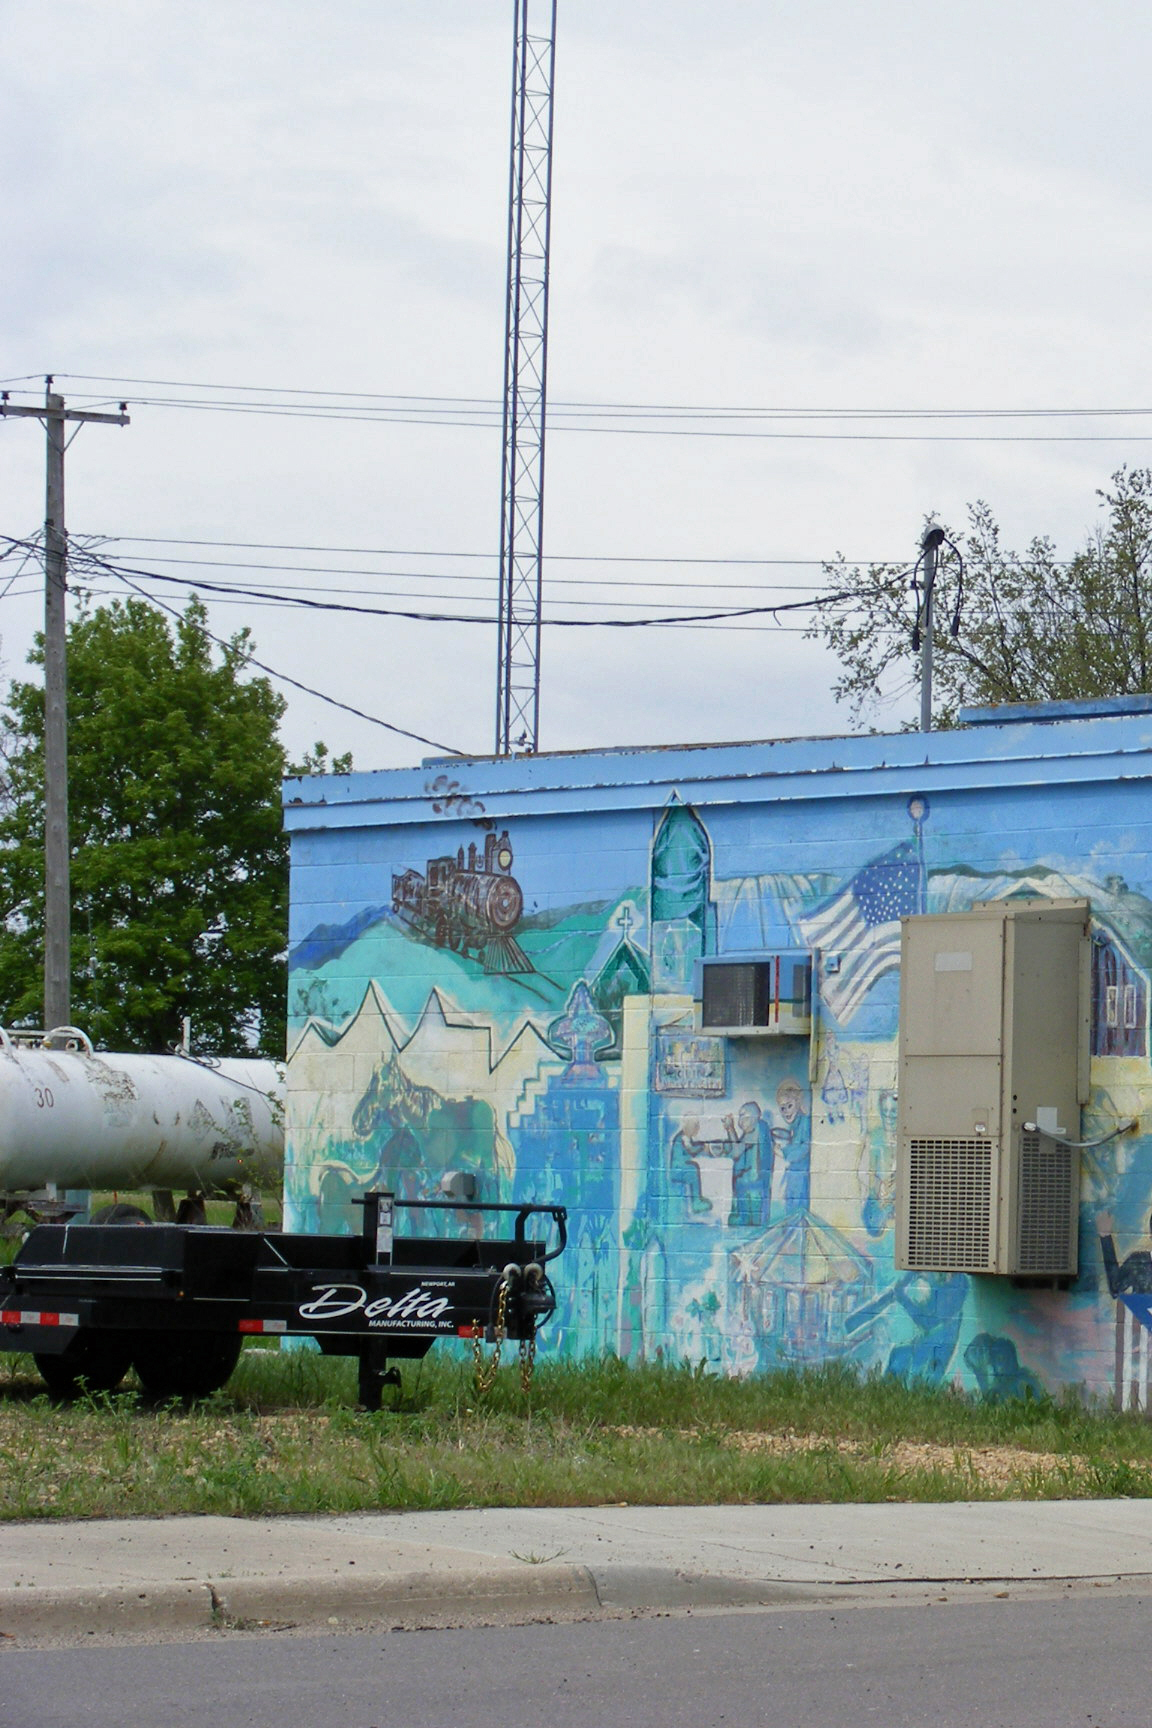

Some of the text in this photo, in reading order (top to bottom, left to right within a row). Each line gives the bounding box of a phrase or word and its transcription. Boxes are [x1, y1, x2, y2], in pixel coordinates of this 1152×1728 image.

[34, 1087, 55, 1108] 30
[299, 1284, 455, 1319] Delta
[368, 1319, 454, 1328] MANUFACTURING, INC.
